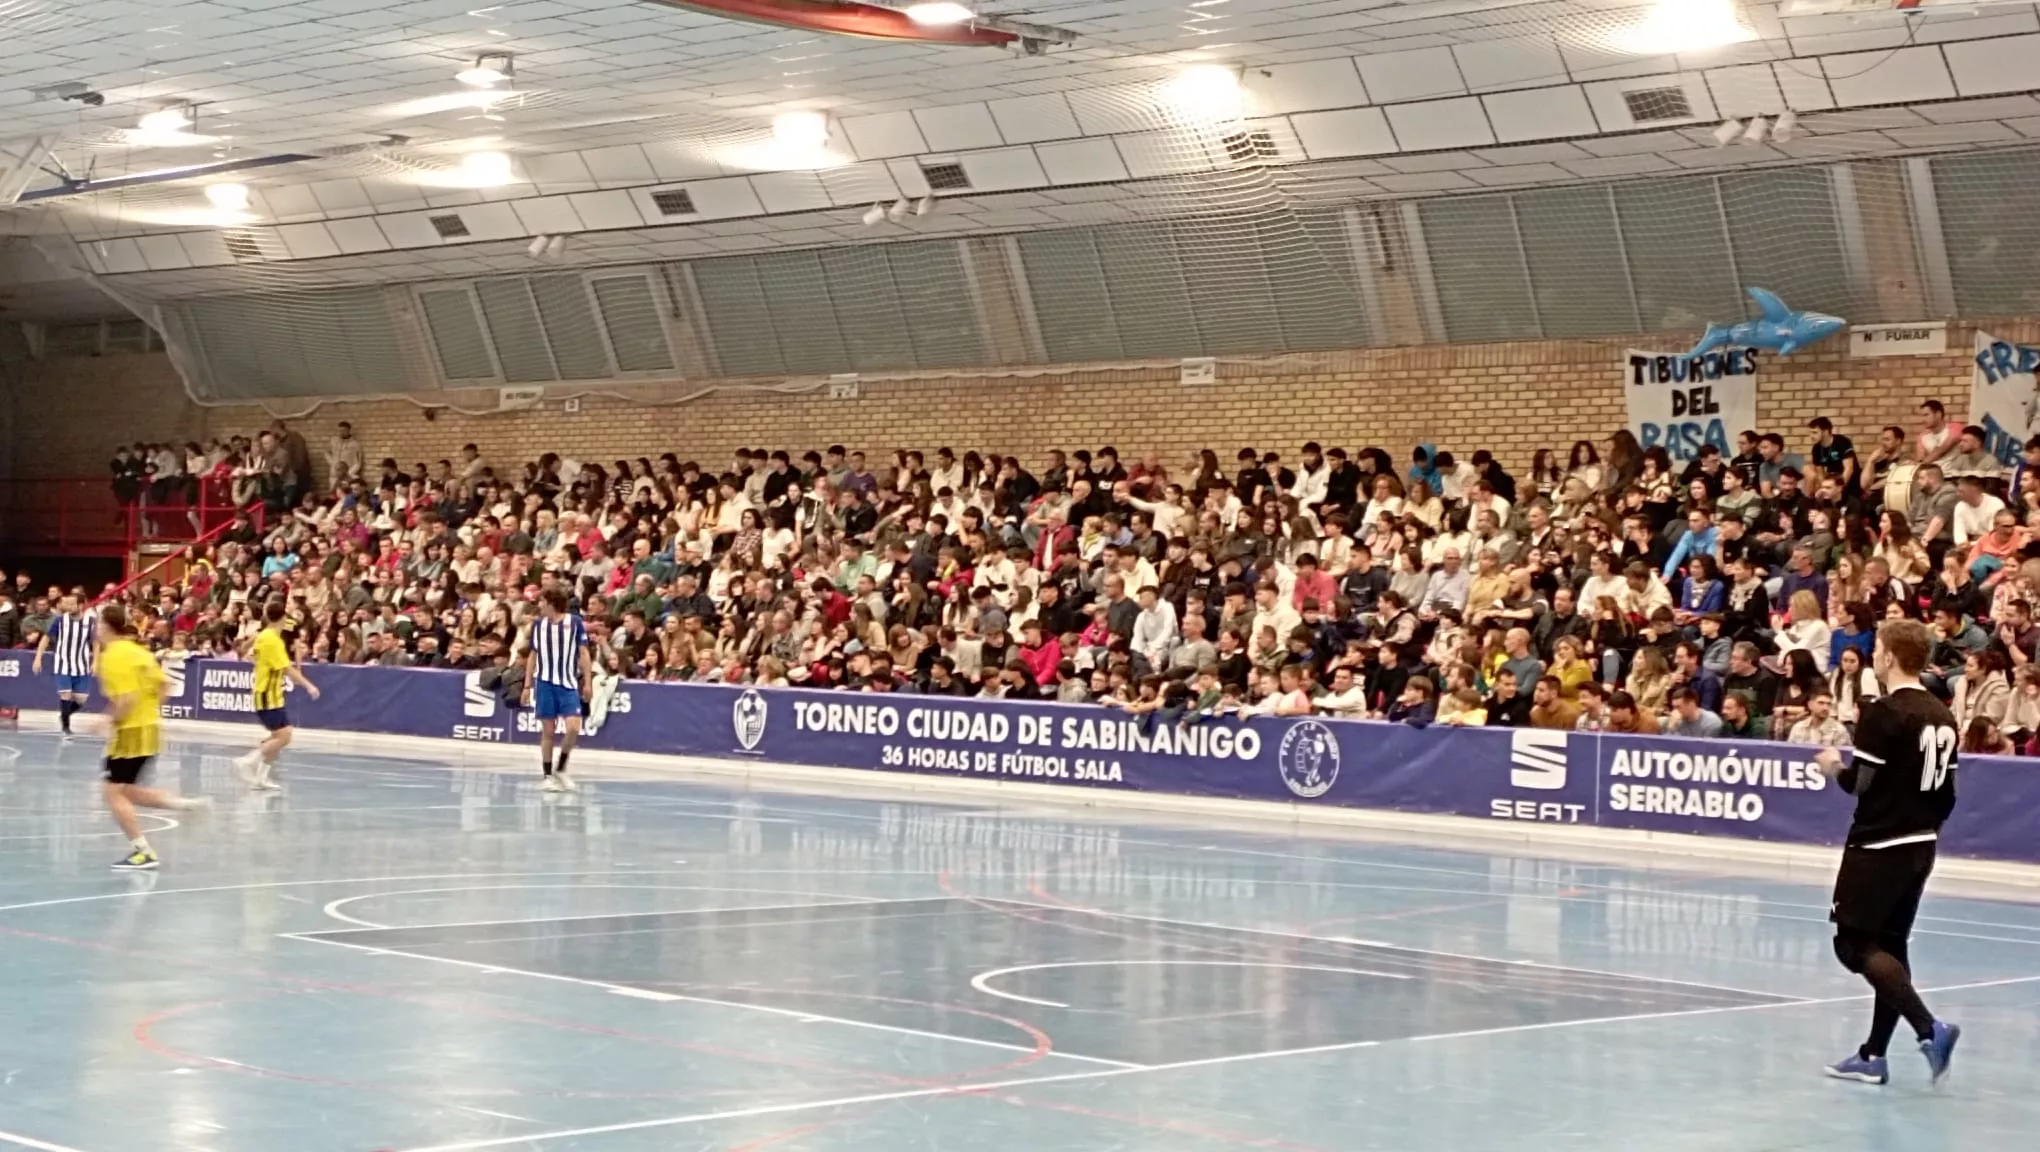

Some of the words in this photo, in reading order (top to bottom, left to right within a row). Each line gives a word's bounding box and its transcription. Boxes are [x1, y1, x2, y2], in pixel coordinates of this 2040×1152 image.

[1672, 386, 1720, 417] DEL
[202, 691, 256, 712] SERRAB
[452, 725, 504, 741] SEAT
[794, 702, 899, 736] TORNEO
[907, 708, 1009, 745] CIUDAD
[1018, 715, 1053, 746] DE
[882, 746, 903, 765] 36
[908, 748, 969, 770] HORAS
[974, 752, 996, 772] DE
[1002, 749, 1069, 778] FÚTBOL
[1074, 758, 1123, 782] SALA
[1610, 749, 1826, 791] AUTOMÓVILES
[1919, 725, 1956, 792] 13
[1490, 798, 1586, 823] SEAT
[1609, 783, 1764, 822] SERRABLO
